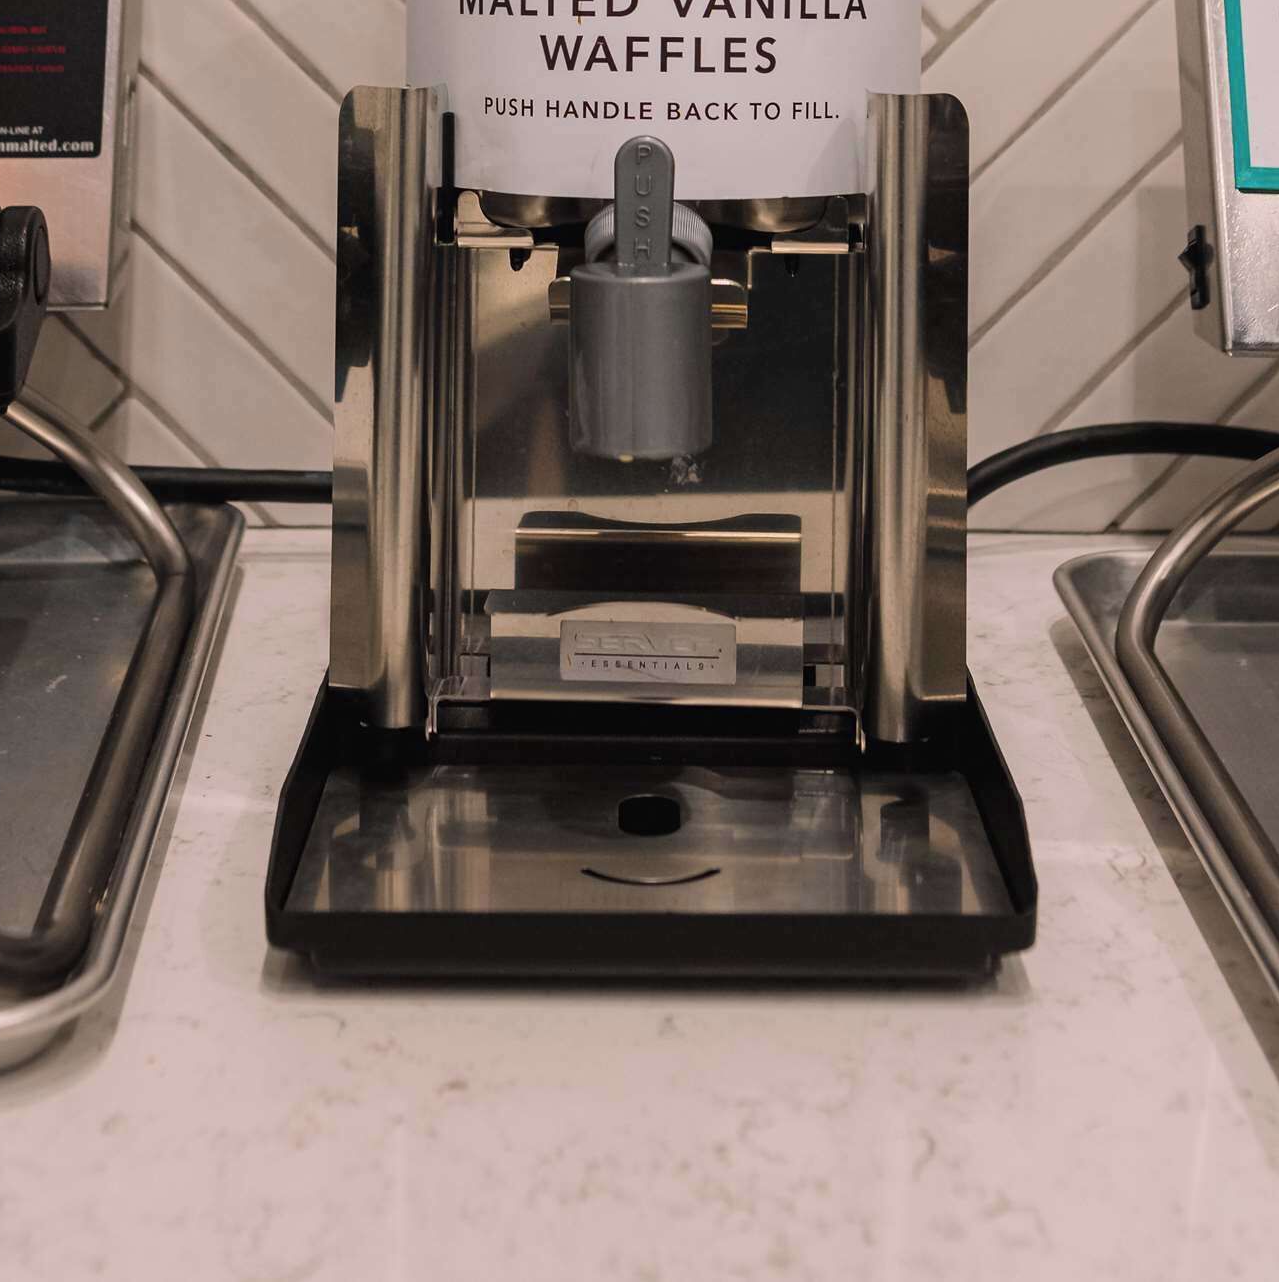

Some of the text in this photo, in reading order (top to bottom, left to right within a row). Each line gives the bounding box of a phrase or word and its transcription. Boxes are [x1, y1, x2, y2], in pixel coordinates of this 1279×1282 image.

[540, 34, 778, 74] WAFFLES
[484, 96, 840, 121] PUSH HANDLE BACK TO FILL.
[32, 125, 43, 135] AT
[634, 144, 652, 259] PUSH
[591, 659, 705, 671] ESSENTIALS
